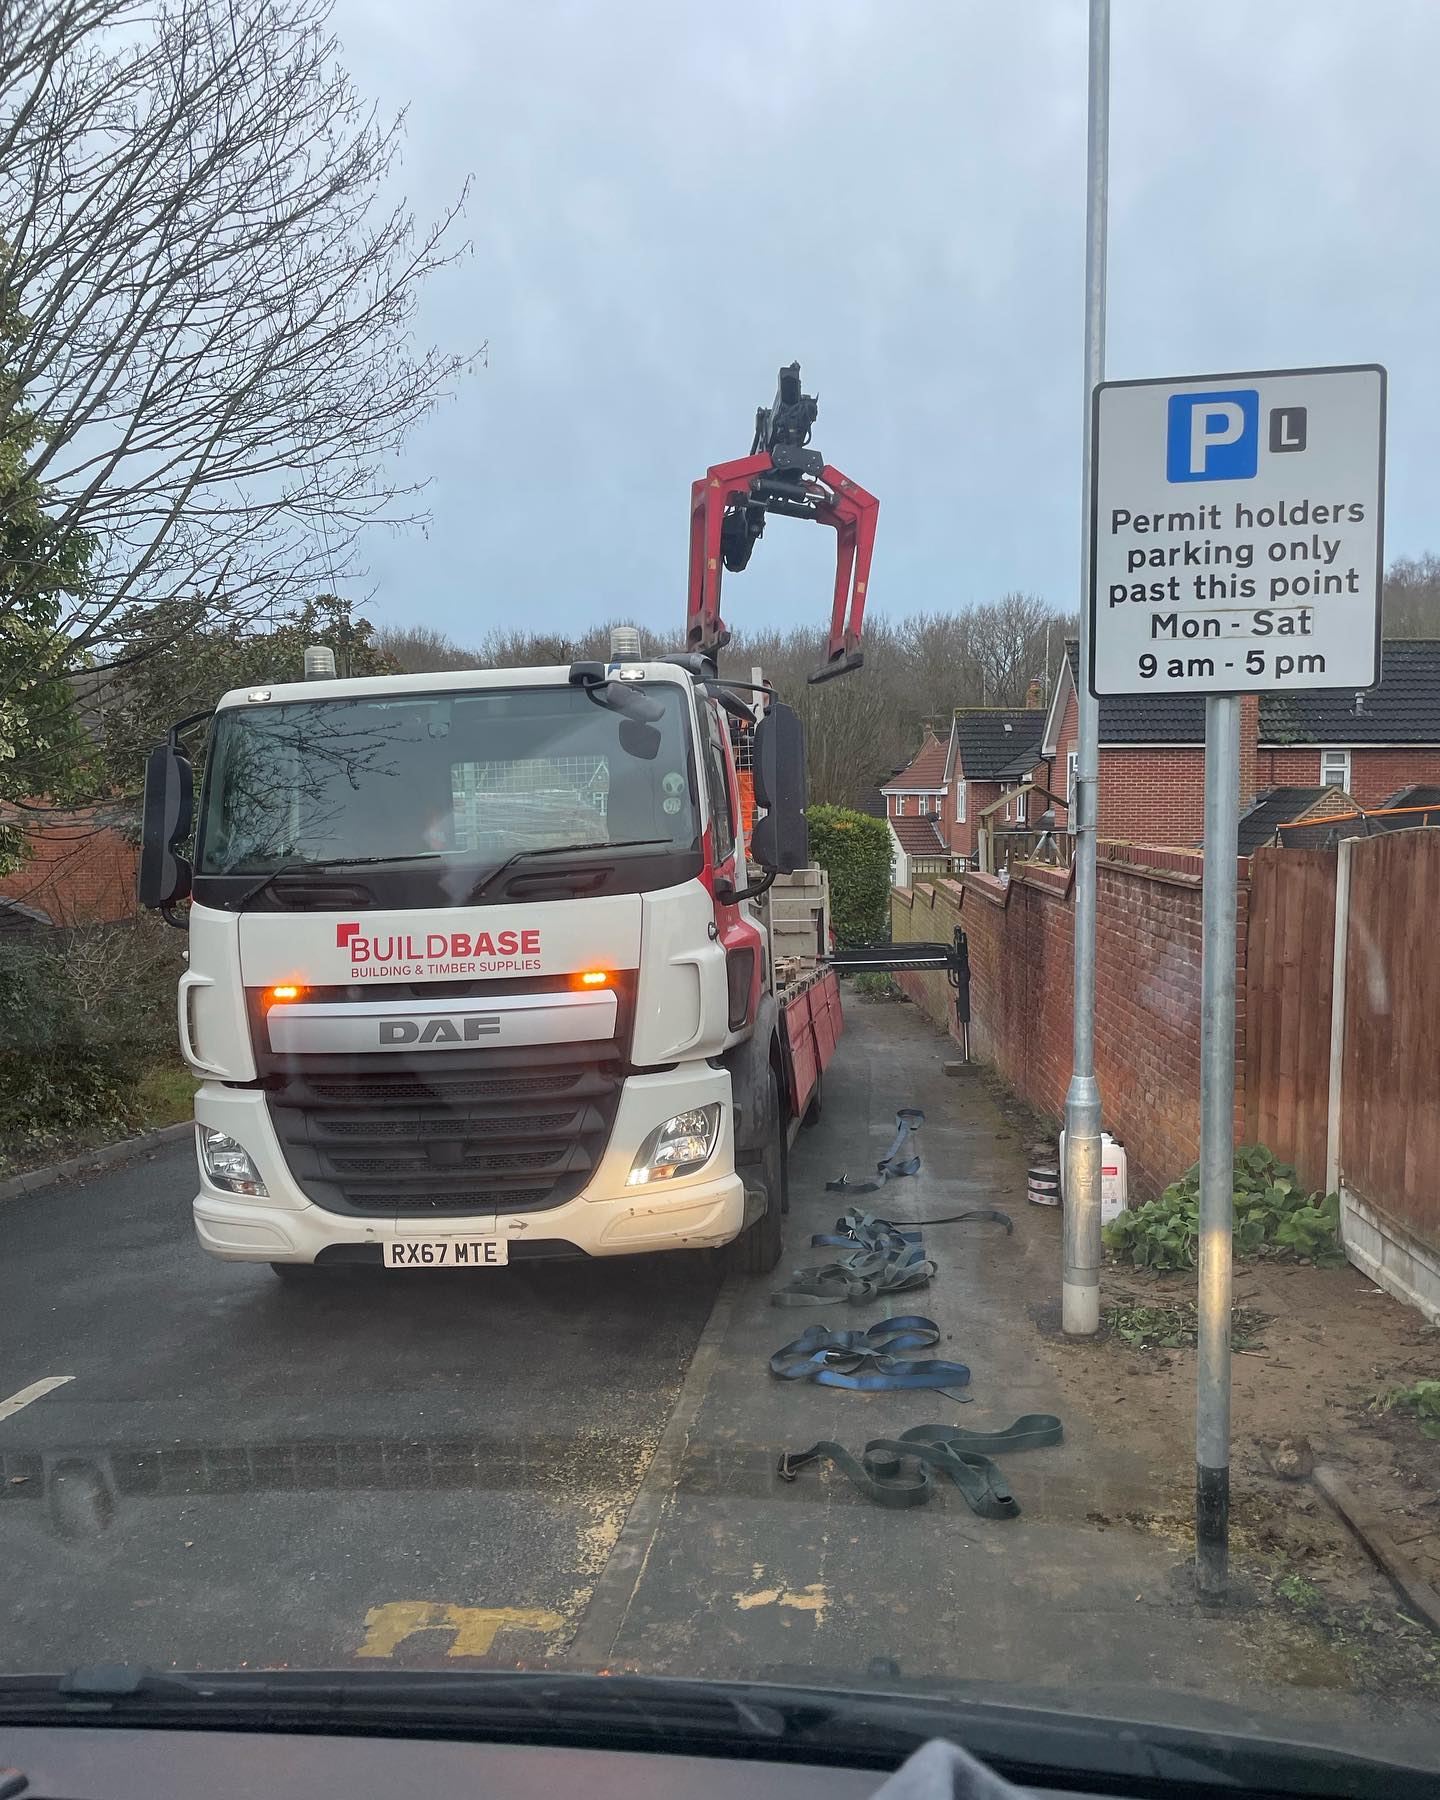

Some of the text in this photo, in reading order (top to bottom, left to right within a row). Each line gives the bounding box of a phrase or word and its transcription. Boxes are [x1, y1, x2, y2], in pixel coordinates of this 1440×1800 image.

[1190, 402, 1244, 473] P
[1281, 415, 1299, 445] L
[1112, 500, 1365, 534] Permit holders
[1128, 535, 1341, 572] parking only
[1109, 568, 1359, 607] past this point
[1151, 613, 1221, 639] Mon
[1250, 609, 1311, 636] Sat
[1138, 653, 1158, 678] 9
[1167, 659, 1214, 677] am
[1245, 650, 1265, 675] 5
[1275, 653, 1326, 679] pm
[351, 930, 541, 962] BUILDBASE
[351, 959, 541, 978] BUILDING & TIMBER SUPPLIES
[380, 1016, 501, 1044] DAF
[392, 1242, 498, 1263] RX67 MTE
